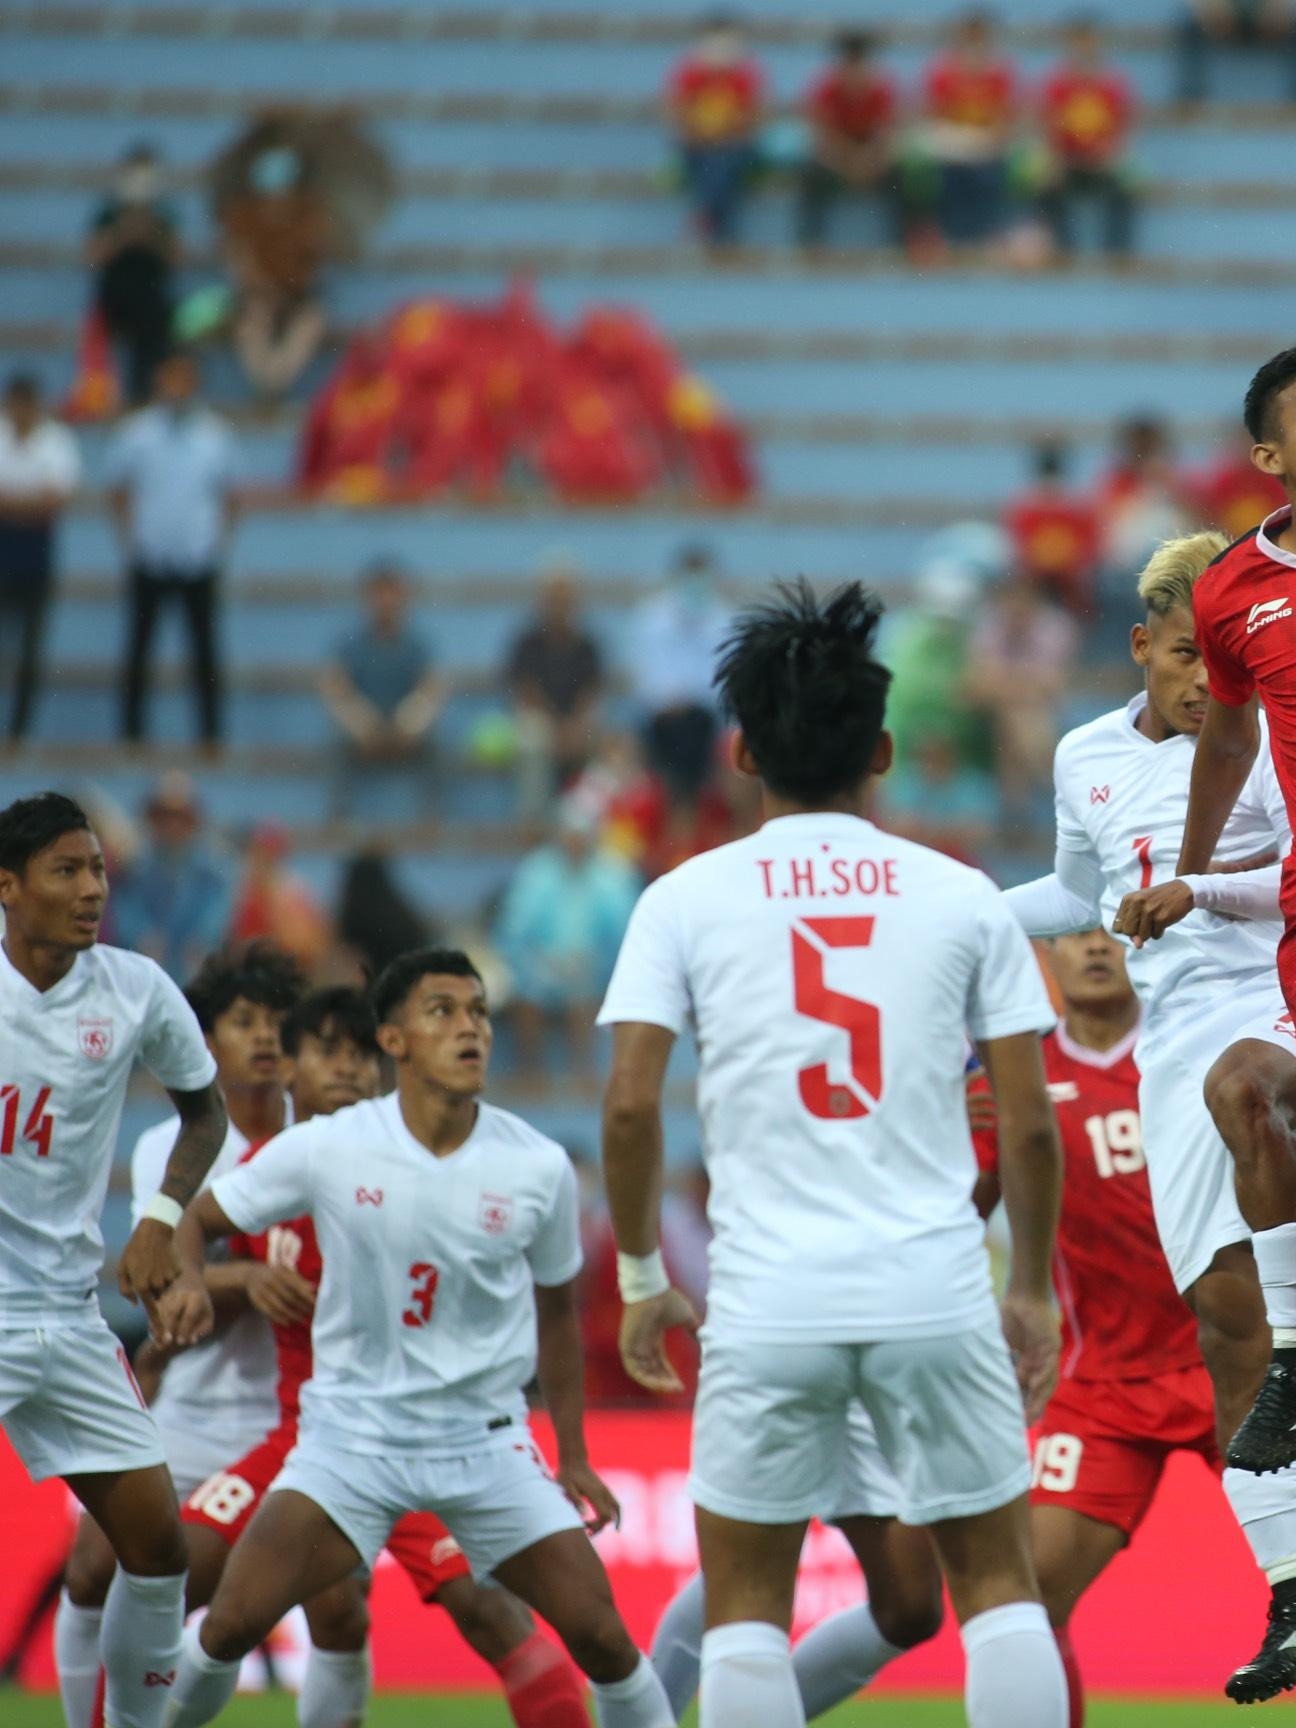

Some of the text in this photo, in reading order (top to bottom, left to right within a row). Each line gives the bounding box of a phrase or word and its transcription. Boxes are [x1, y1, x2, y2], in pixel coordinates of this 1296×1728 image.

[1246, 607, 1293, 634] LI-NING
[757, 859, 901, 898] T.H.SOE
[790, 914, 883, 1121] 5
[0, 1083, 53, 1157] 14
[1084, 1108, 1145, 1178] 19
[402, 1260, 440, 1328] 3
[1030, 1432, 1084, 1493] 19
[188, 1471, 255, 1525] 18
